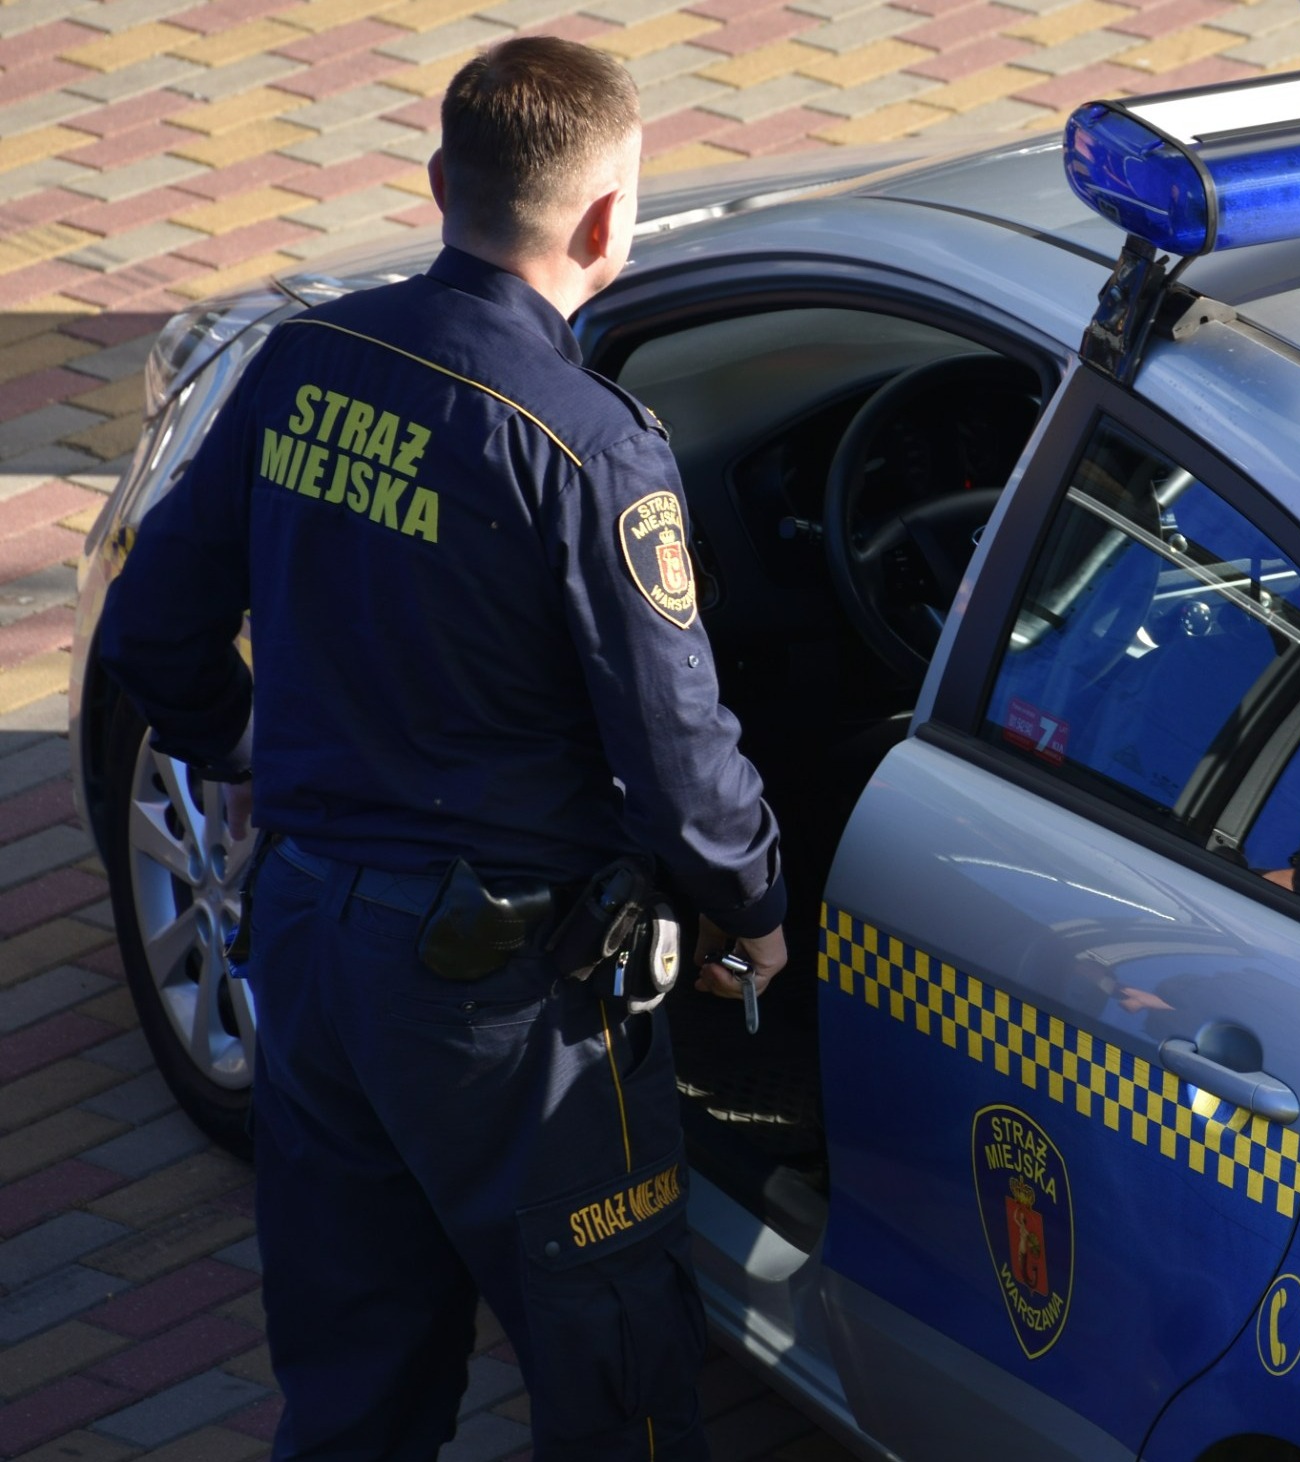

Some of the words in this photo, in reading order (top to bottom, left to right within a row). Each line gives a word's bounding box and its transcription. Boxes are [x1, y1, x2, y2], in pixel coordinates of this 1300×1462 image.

[288, 383, 432, 478] STRAŻ
[259, 427, 439, 543] MIEJSKA
[991, 1116, 1049, 1167] STRAŻ
[985, 1144, 1057, 1204] MIEJSKA
[570, 1191, 634, 1247] STRAŻ
[1000, 1262, 1064, 1331] WARSZAWA
